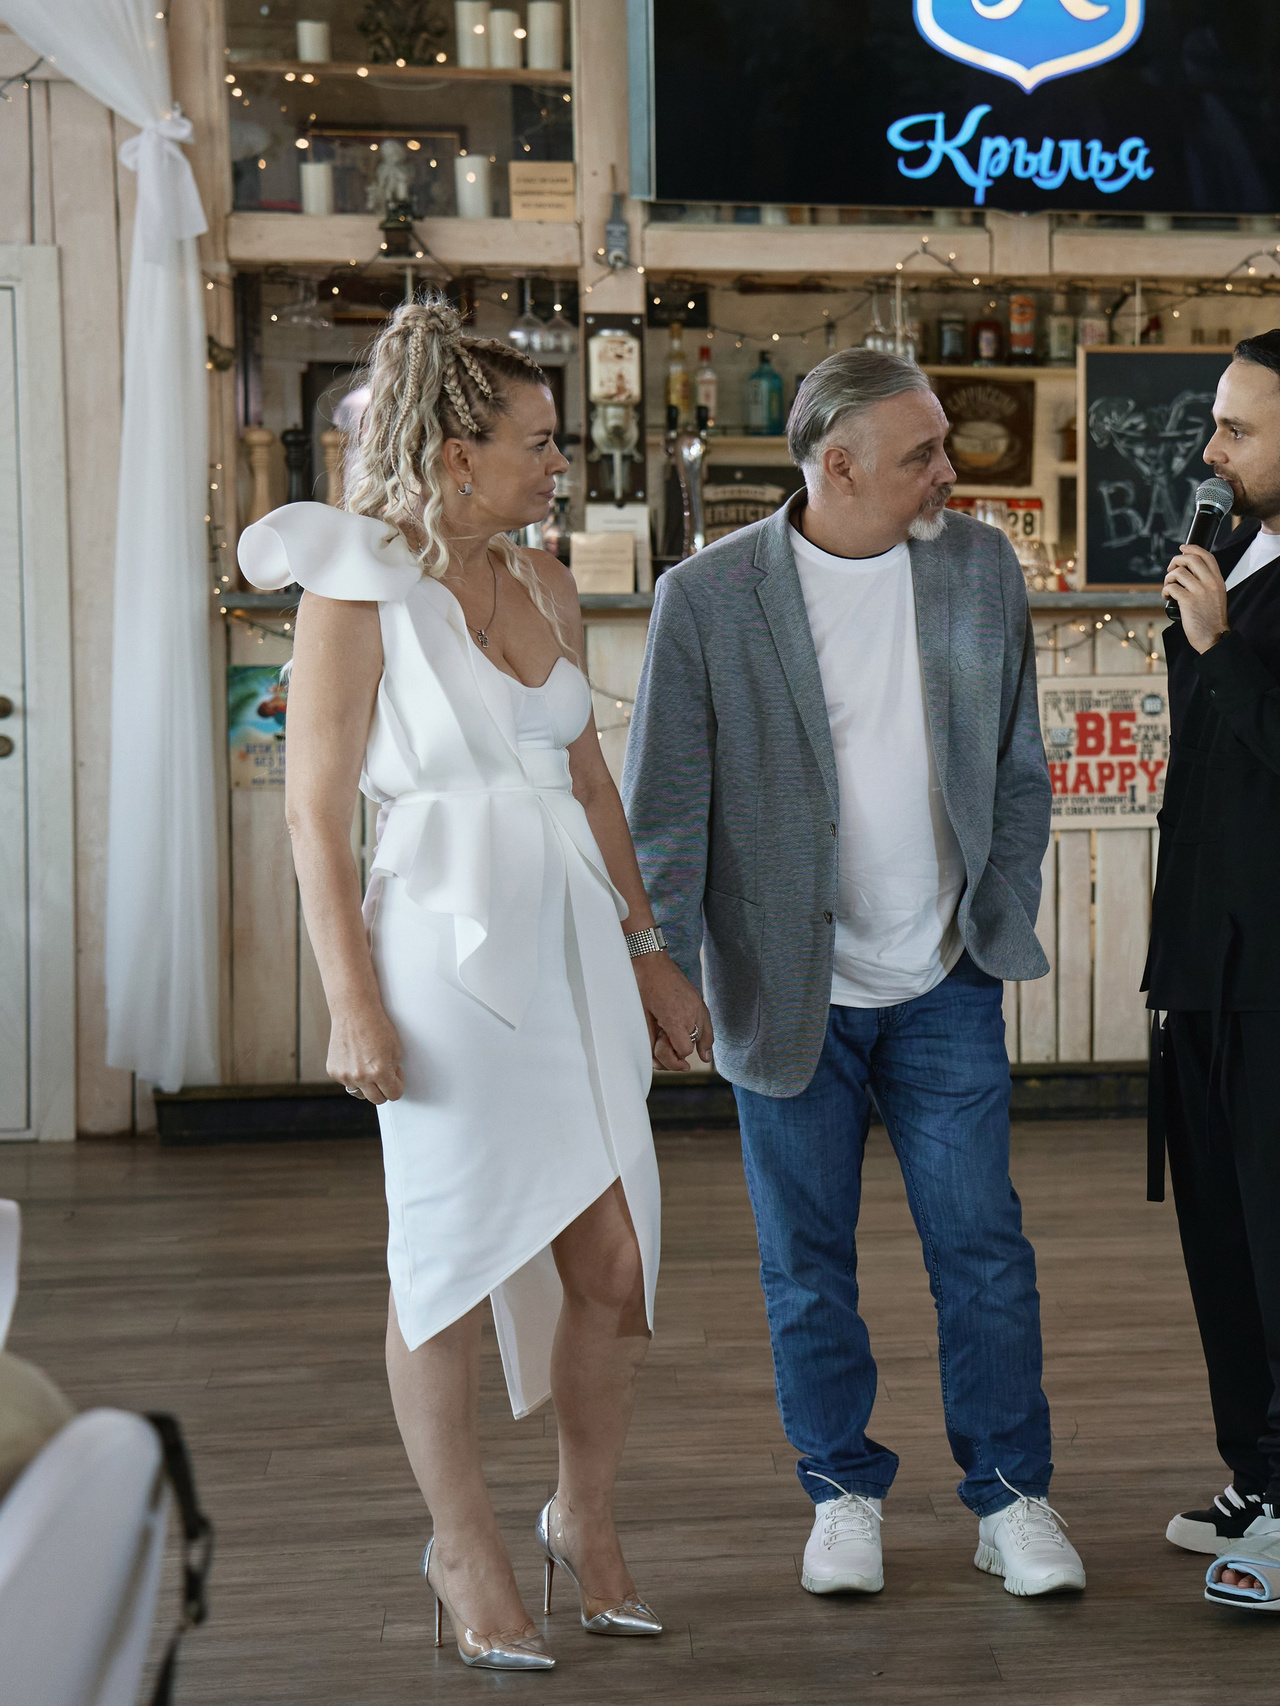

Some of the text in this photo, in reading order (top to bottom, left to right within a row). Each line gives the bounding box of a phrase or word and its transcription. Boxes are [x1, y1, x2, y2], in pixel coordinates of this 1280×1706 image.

[886, 104, 1155, 206] Крылья
[1075, 711, 1137, 757] BE
[1048, 761, 1165, 794] HAPPY
